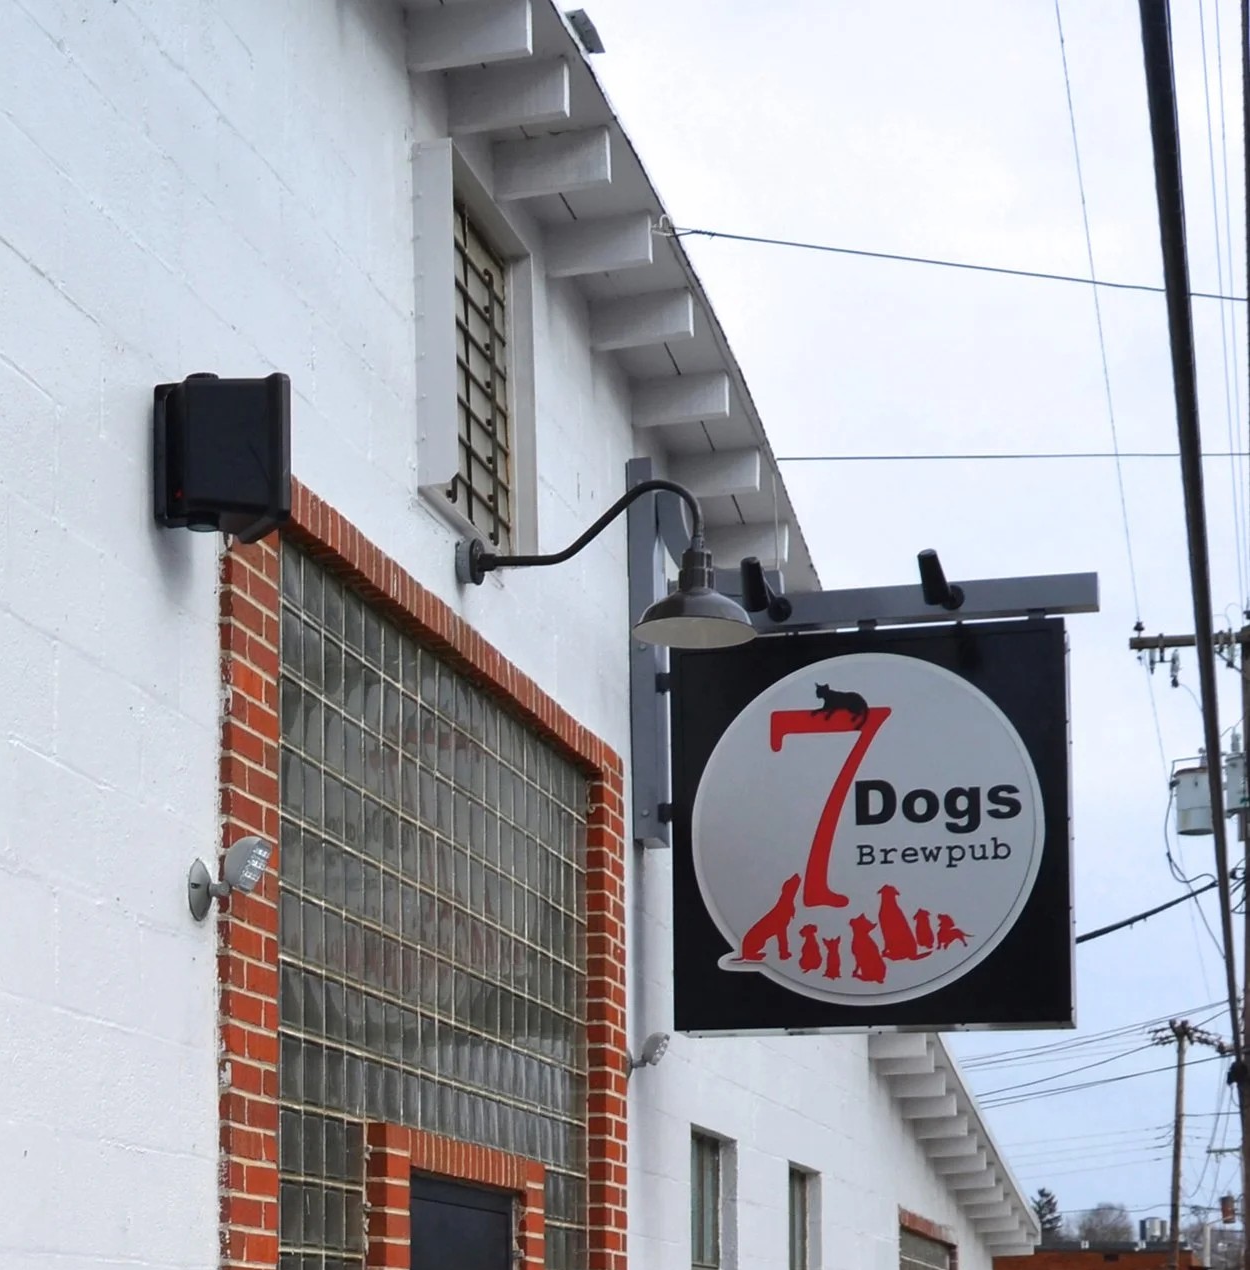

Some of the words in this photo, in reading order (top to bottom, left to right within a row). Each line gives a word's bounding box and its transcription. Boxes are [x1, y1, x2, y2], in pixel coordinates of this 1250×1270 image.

[770, 706, 892, 908] 7
[854, 779, 1022, 834] Dogs
[856, 836, 1012, 869] Brewpub
